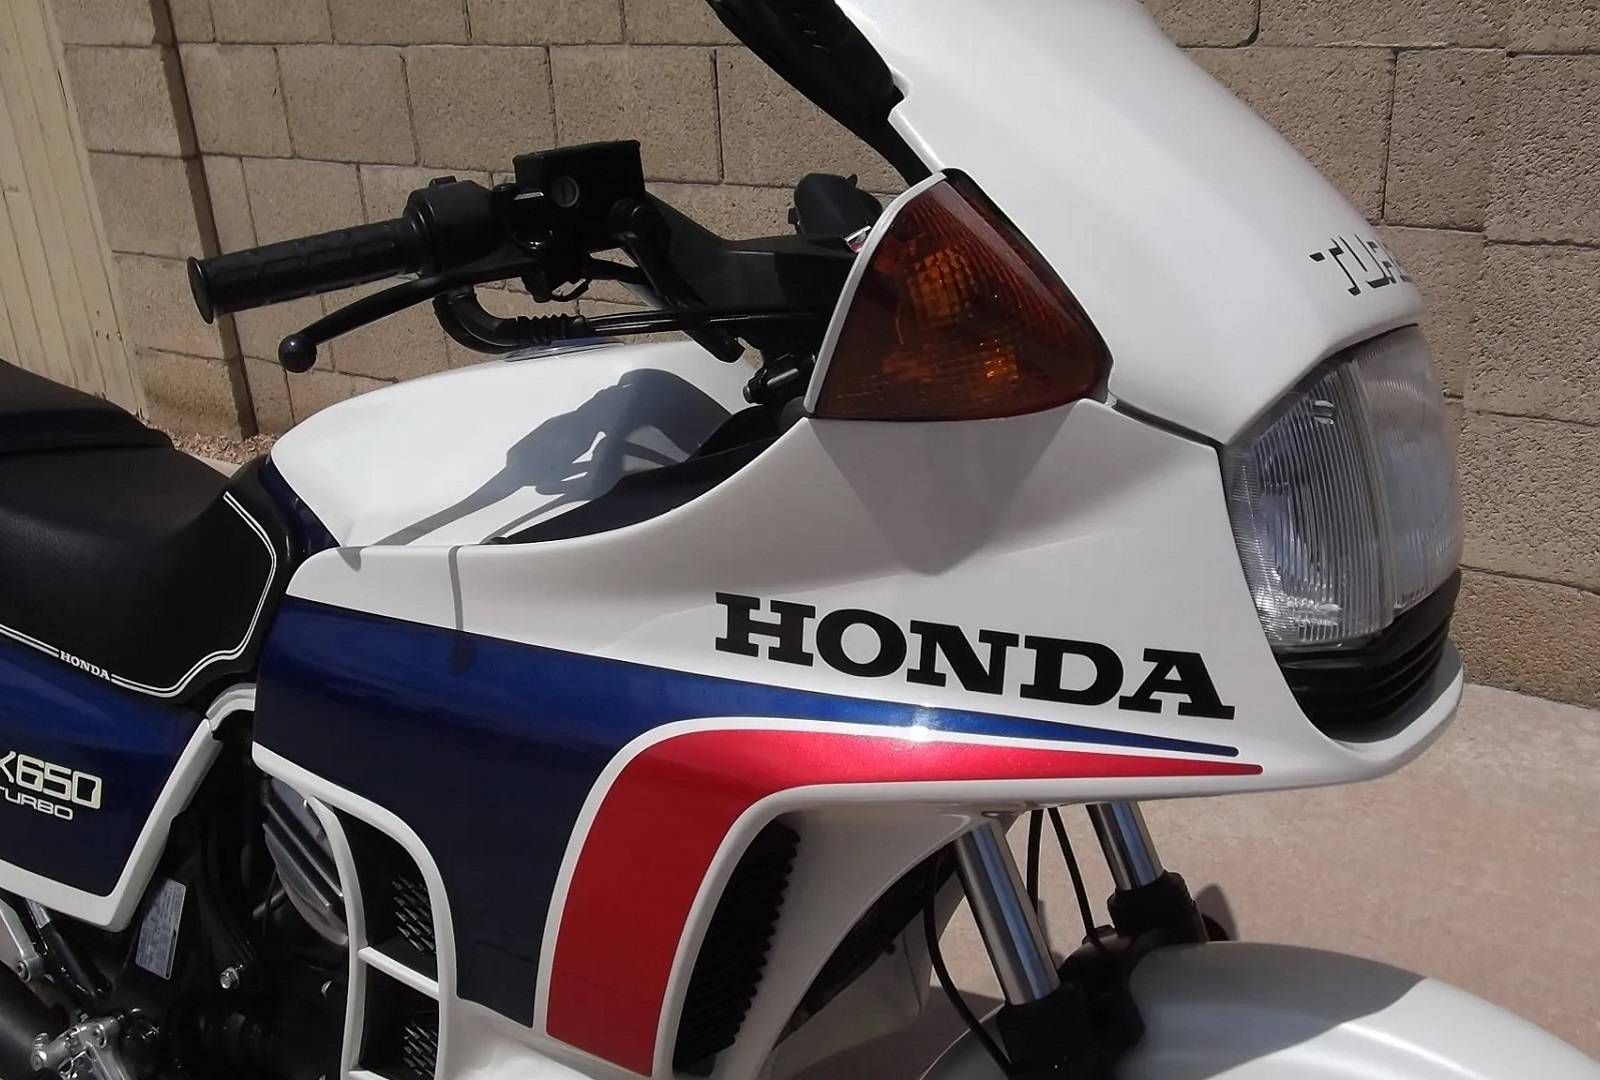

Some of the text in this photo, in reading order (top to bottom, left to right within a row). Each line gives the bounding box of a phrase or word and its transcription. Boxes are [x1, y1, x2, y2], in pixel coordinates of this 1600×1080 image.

[60, 650, 110, 681] HONDA
[715, 592, 1236, 721] HONDA
[0, 786, 73, 820] URBO
